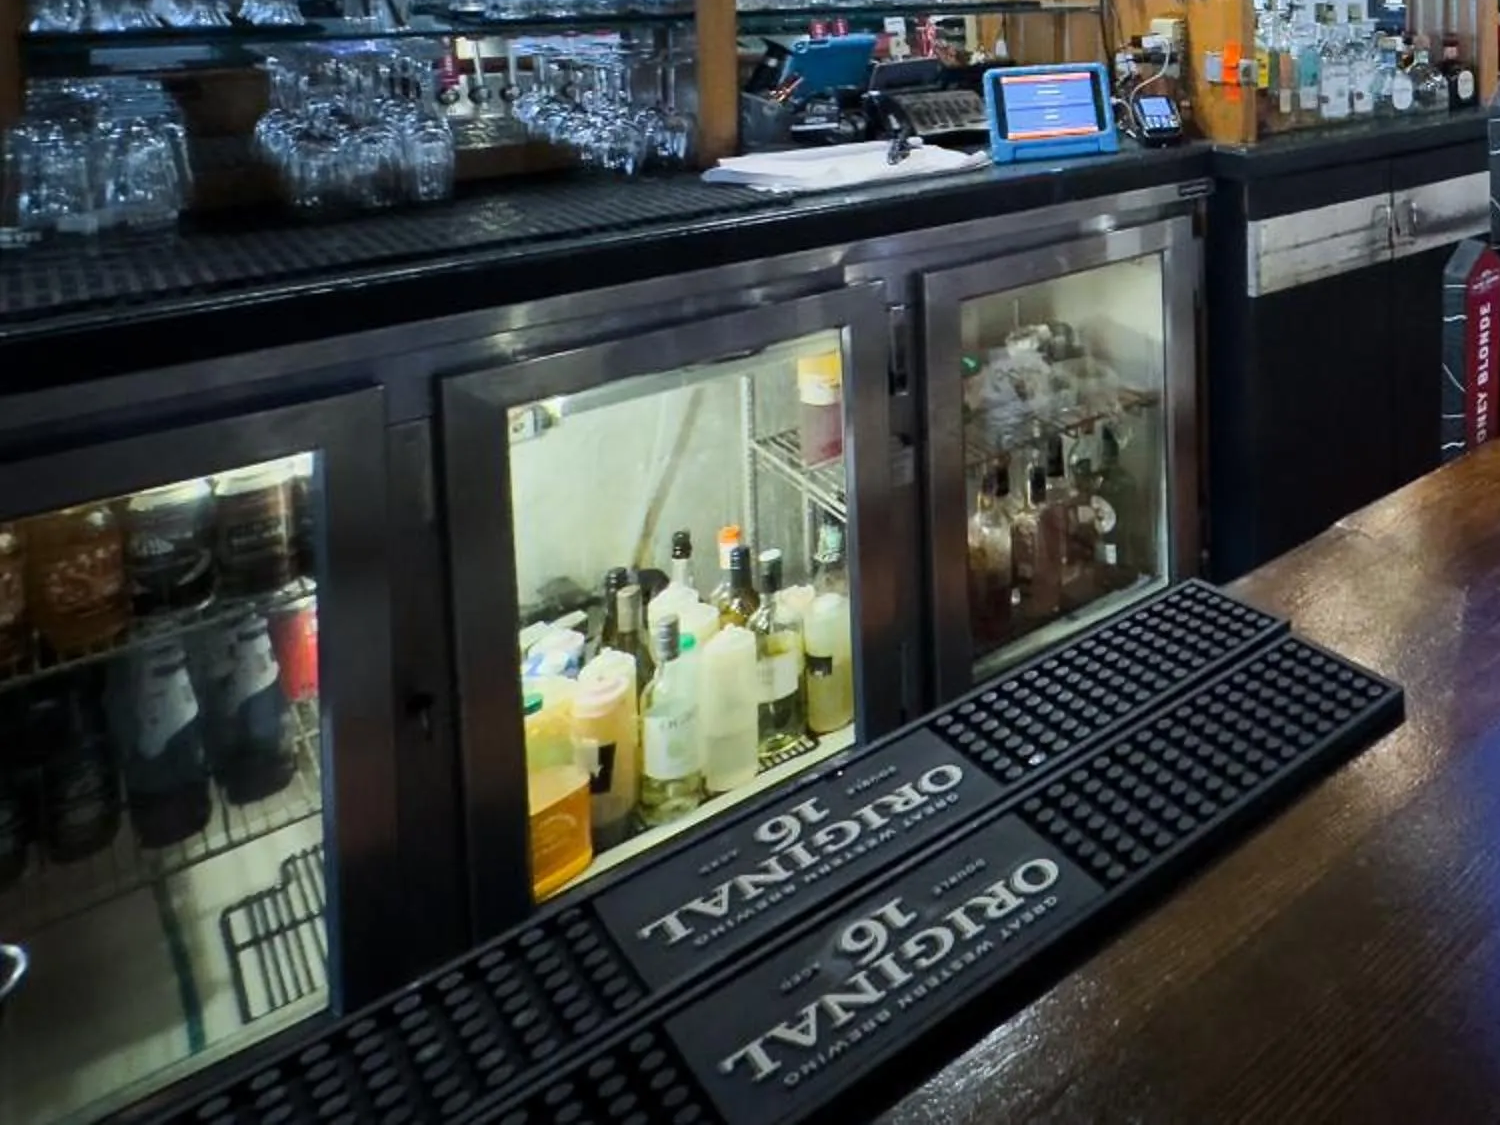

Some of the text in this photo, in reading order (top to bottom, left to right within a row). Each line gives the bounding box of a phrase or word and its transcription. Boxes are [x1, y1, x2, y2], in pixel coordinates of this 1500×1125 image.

[1476, 303, 1491, 442] ONEY BLONDE
[753, 796, 831, 852] 16
[845, 765, 898, 796] DOUBLE
[636, 762, 964, 946] ORIGINAL
[692, 792, 960, 947] GREAT WESTERN BREWING
[930, 857, 987, 897] DOUBLE
[717, 856, 1060, 1082] ORIGINAL
[779, 961, 821, 992] AGED
[839, 895, 918, 967] 16
[782, 895, 1058, 1088] GREAT WESTERN BREWING
